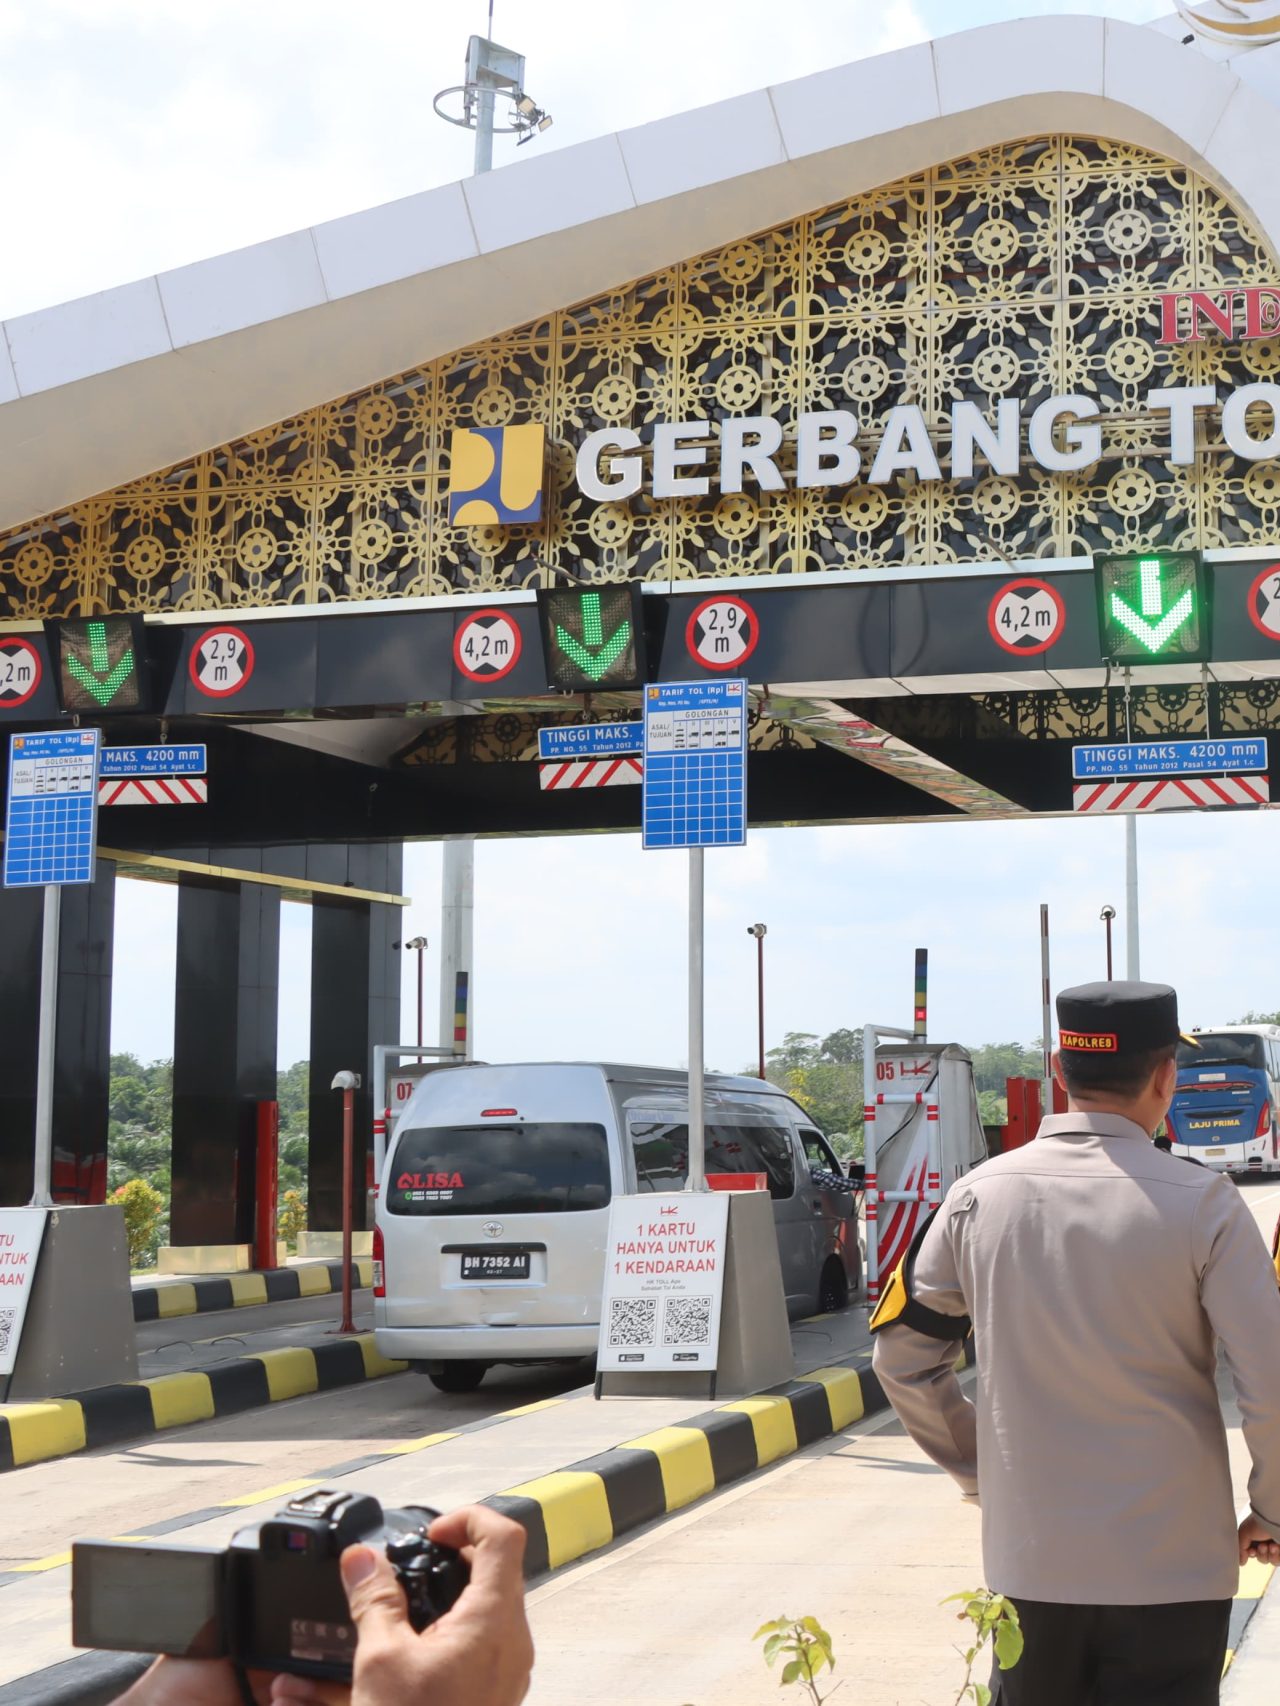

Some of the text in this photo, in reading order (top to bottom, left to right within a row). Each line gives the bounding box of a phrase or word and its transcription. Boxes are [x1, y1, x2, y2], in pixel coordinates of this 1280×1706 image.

[575, 394, 1102, 501] GERBANG
[709, 607, 737, 634] 2,9
[211, 638, 236, 663] 2,9
[715, 635, 730, 653] m
[214, 665, 228, 681] m
[661, 688, 684, 696] TARIF
[688, 687, 703, 695] TOL
[685, 710, 729, 719] GOLONGAN
[26, 738, 46, 747] TARIF
[50, 737, 62, 745] TOL
[547, 727, 633, 743] TINGGI MAKS.
[593, 743, 614, 751] Tahun
[1083, 744, 1258, 763] TINGGI MAKS. 4200 mm
[45, 757, 83, 765] GOLONGAN
[106, 751, 138, 763] MAKS.
[146, 750, 174, 761] 4200
[179, 750, 199, 760] mm
[1062, 1034, 1112, 1048] KAPOLRES
[876, 1061, 895, 1081] 05
[900, 1060, 931, 1076] HK
[396, 1082, 412, 1101] 07
[1189, 1119, 1240, 1129] LAJU PRIMA
[661, 1206, 678, 1215] HK
[637, 1222, 695, 1237] 1 KARTU
[616, 1239, 715, 1255] HANYA UNTUK
[464, 1256, 526, 1268] BH 7352 AI
[614, 1258, 715, 1274] 1 KENDARAAN
